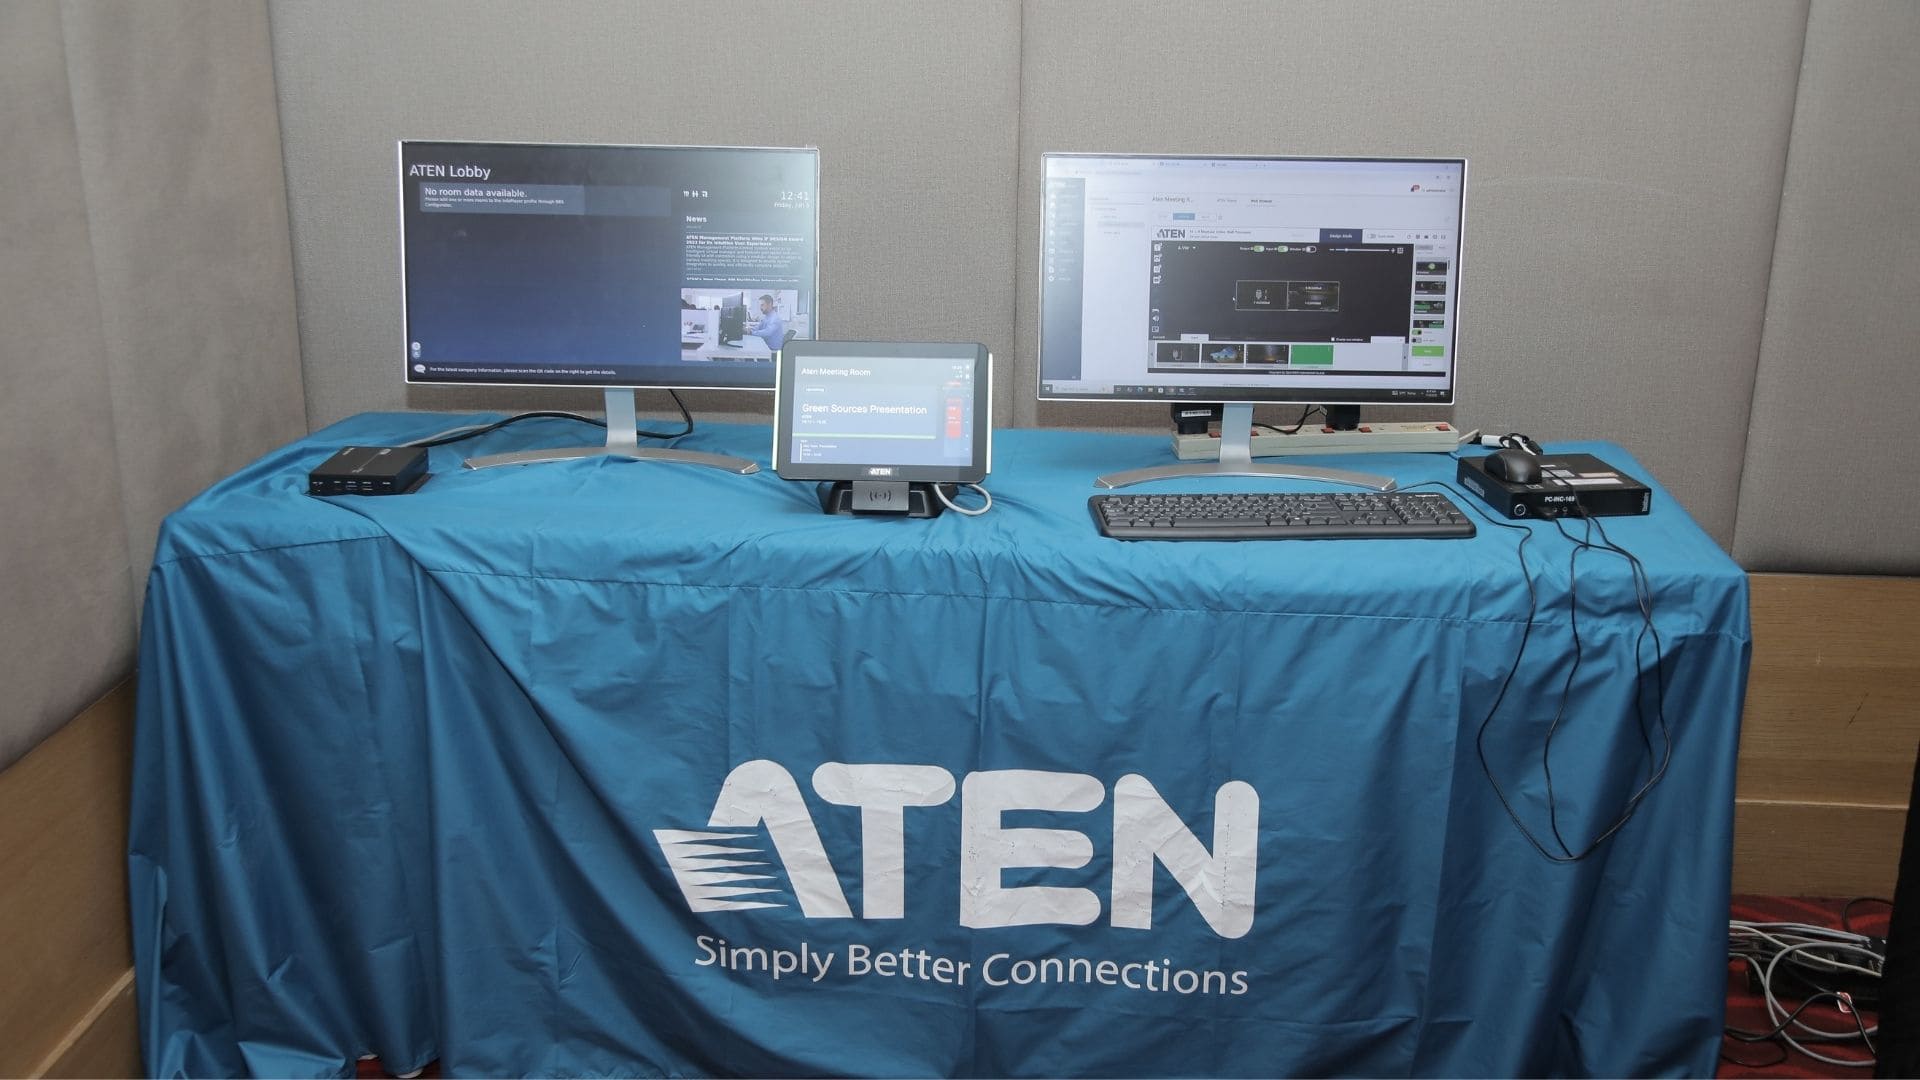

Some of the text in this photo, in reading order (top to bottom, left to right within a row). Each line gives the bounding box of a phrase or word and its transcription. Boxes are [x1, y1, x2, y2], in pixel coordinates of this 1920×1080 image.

[409, 164, 491, 181] ATEN Lobby
[424, 187, 528, 198] No room data available.
[780, 191, 809, 201] 12:41
[686, 215, 707, 223] News
[1156, 228, 1186, 239] ATEN
[801, 367, 871, 378] Aten Meeting Room
[802, 403, 928, 415] Green Sources Presentation
[868, 467, 891, 476] ATEN
[653, 759, 1260, 940] ATEN
[694, 934, 1249, 996] Simply Better Connections
